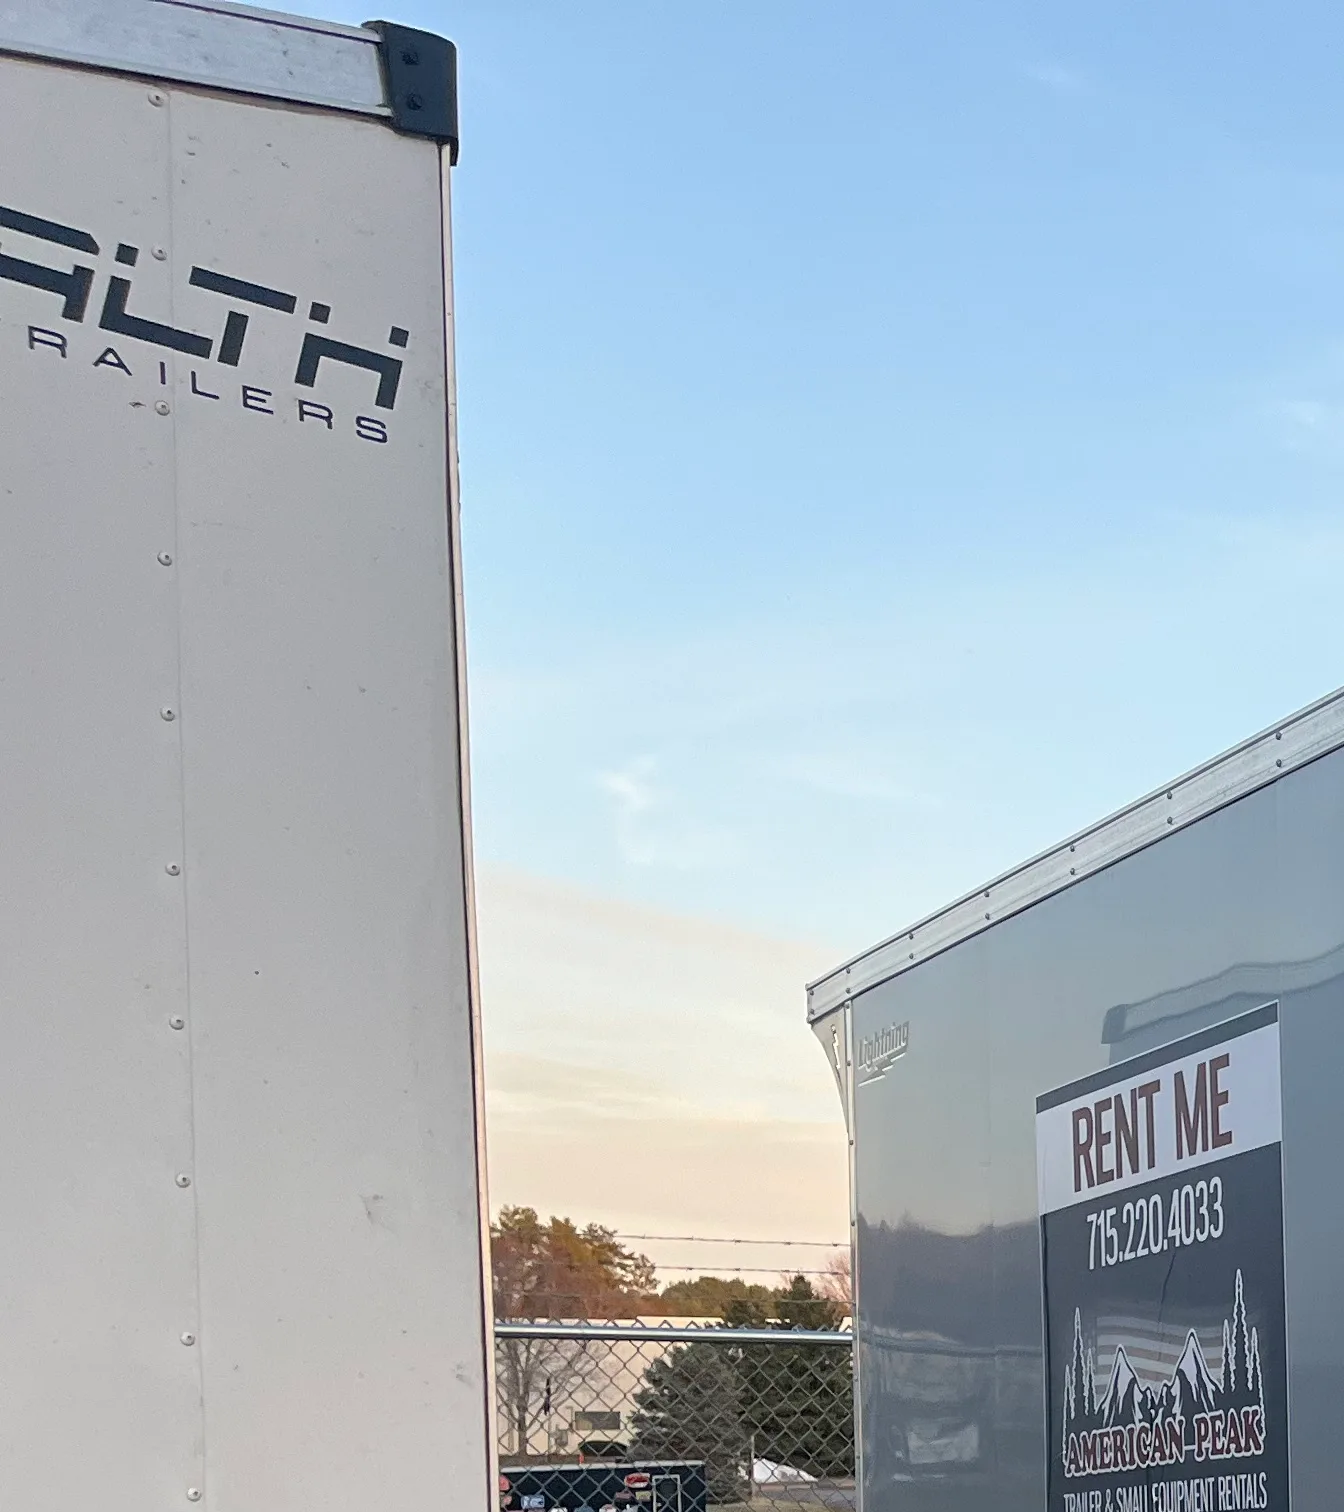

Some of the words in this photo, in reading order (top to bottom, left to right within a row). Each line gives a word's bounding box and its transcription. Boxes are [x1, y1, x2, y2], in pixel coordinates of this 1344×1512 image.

[0, 318, 388, 443] RAILERS
[1071, 1079, 1161, 1193] RENT
[1174, 1053, 1233, 1160] ME
[1086, 1176, 1224, 1270] 715.220.4033
[1064, 1416, 1185, 1478] AMERICAN
[1193, 1405, 1264, 1461] PEAK
[1218, 1472, 1267, 1511] RENTALS
